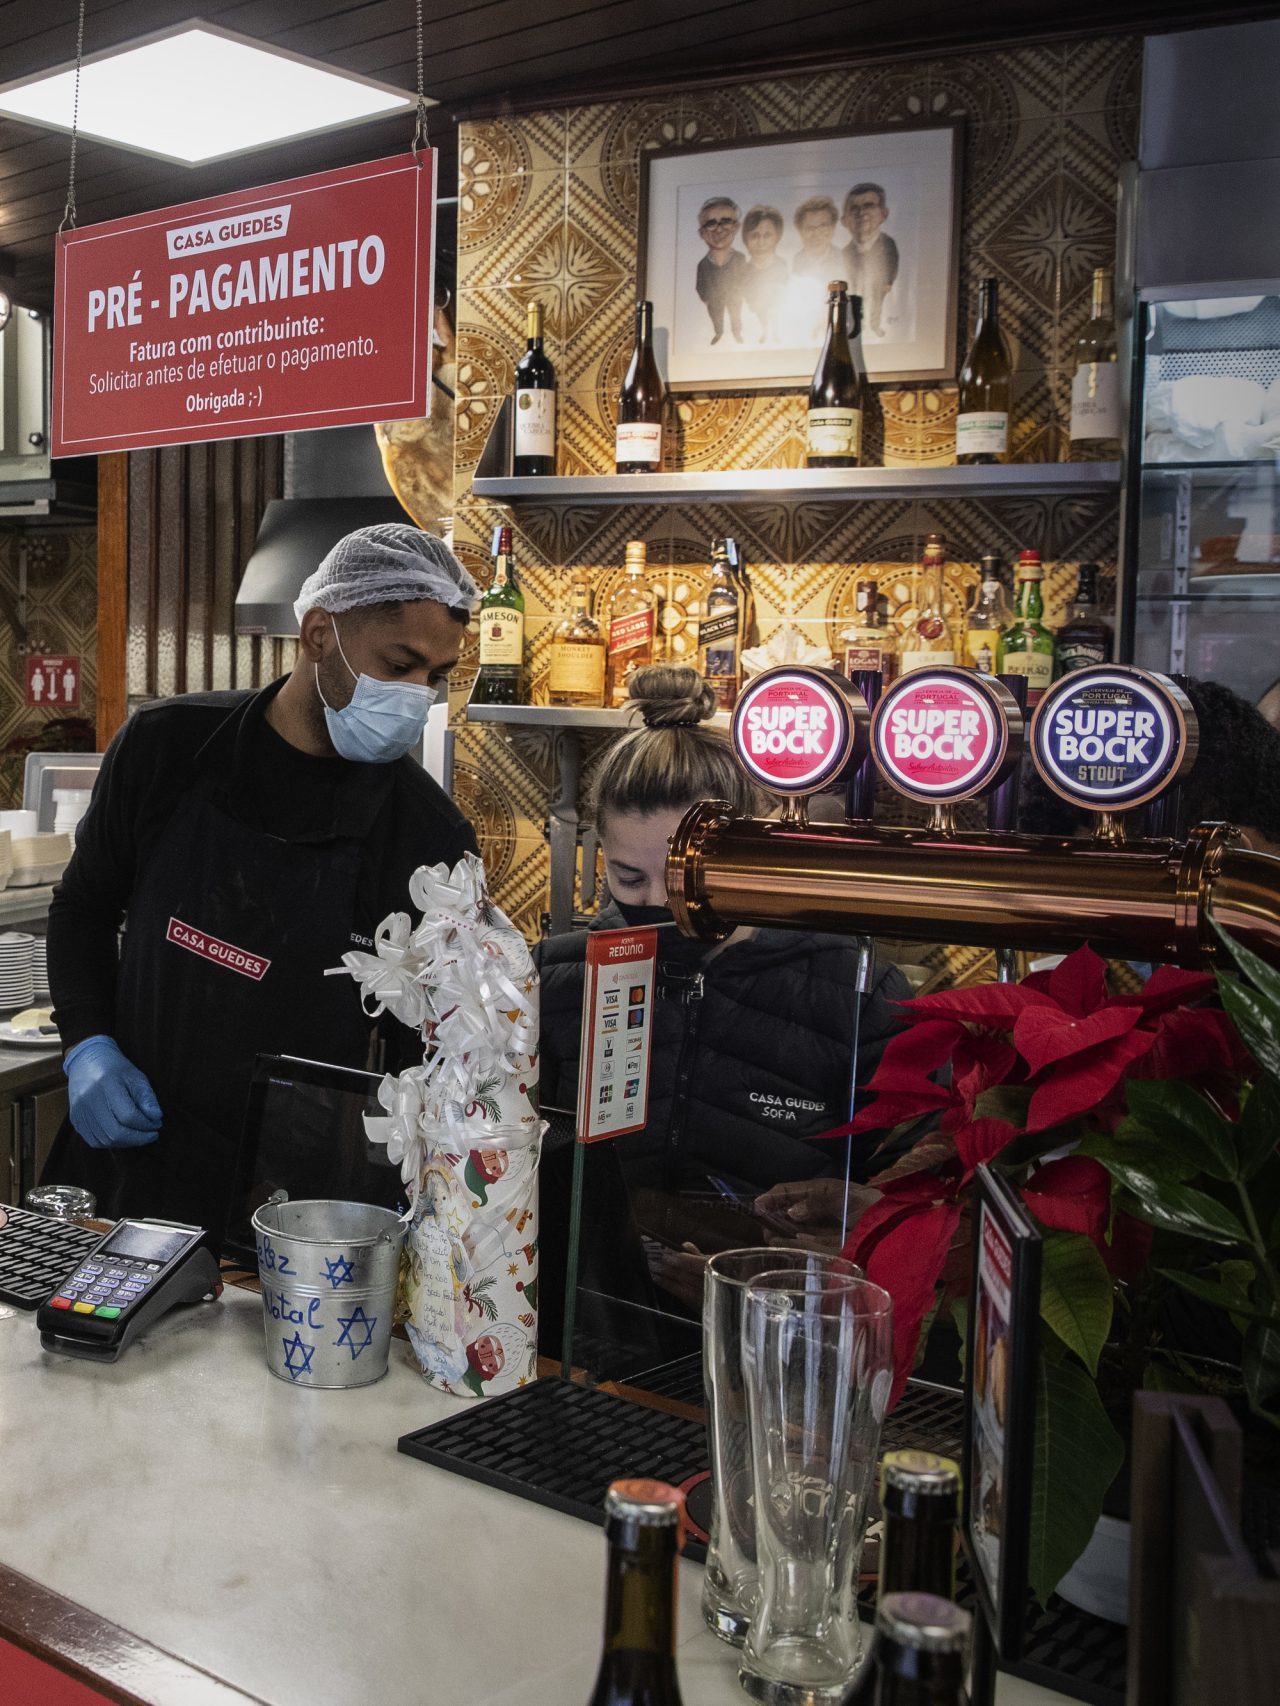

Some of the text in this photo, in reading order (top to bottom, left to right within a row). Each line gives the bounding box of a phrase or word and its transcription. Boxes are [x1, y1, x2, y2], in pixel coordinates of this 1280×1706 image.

[173, 214, 284, 252] CASA GUEDES
[87, 234, 386, 333] PRÉ - PAGAMENTO
[129, 314, 326, 363] Fatura com contribuinte:
[89, 336, 380, 395] Solicitar antes de efetuar o pagamento.
[186, 386, 264, 414] Obrigada ;-)
[481, 612, 520, 624] AMESON
[747, 706, 827, 730] SUPER
[891, 709, 980, 736] SUPER
[1056, 709, 1155, 738] SUPER
[751, 730, 823, 754] BOCK
[894, 734, 974, 761] BOCK
[1059, 735, 1149, 764] BOCK
[1078, 765, 1127, 782] STOUT
[173, 926, 262, 974] CASA GUEDES
[350, 933, 373, 947] EDES
[606, 994, 618, 1004] VISA
[604, 1018, 617, 1028] VISA
[749, 1092, 826, 1111] CASA GUEDES
[761, 1106, 796, 1120] SOFIA
